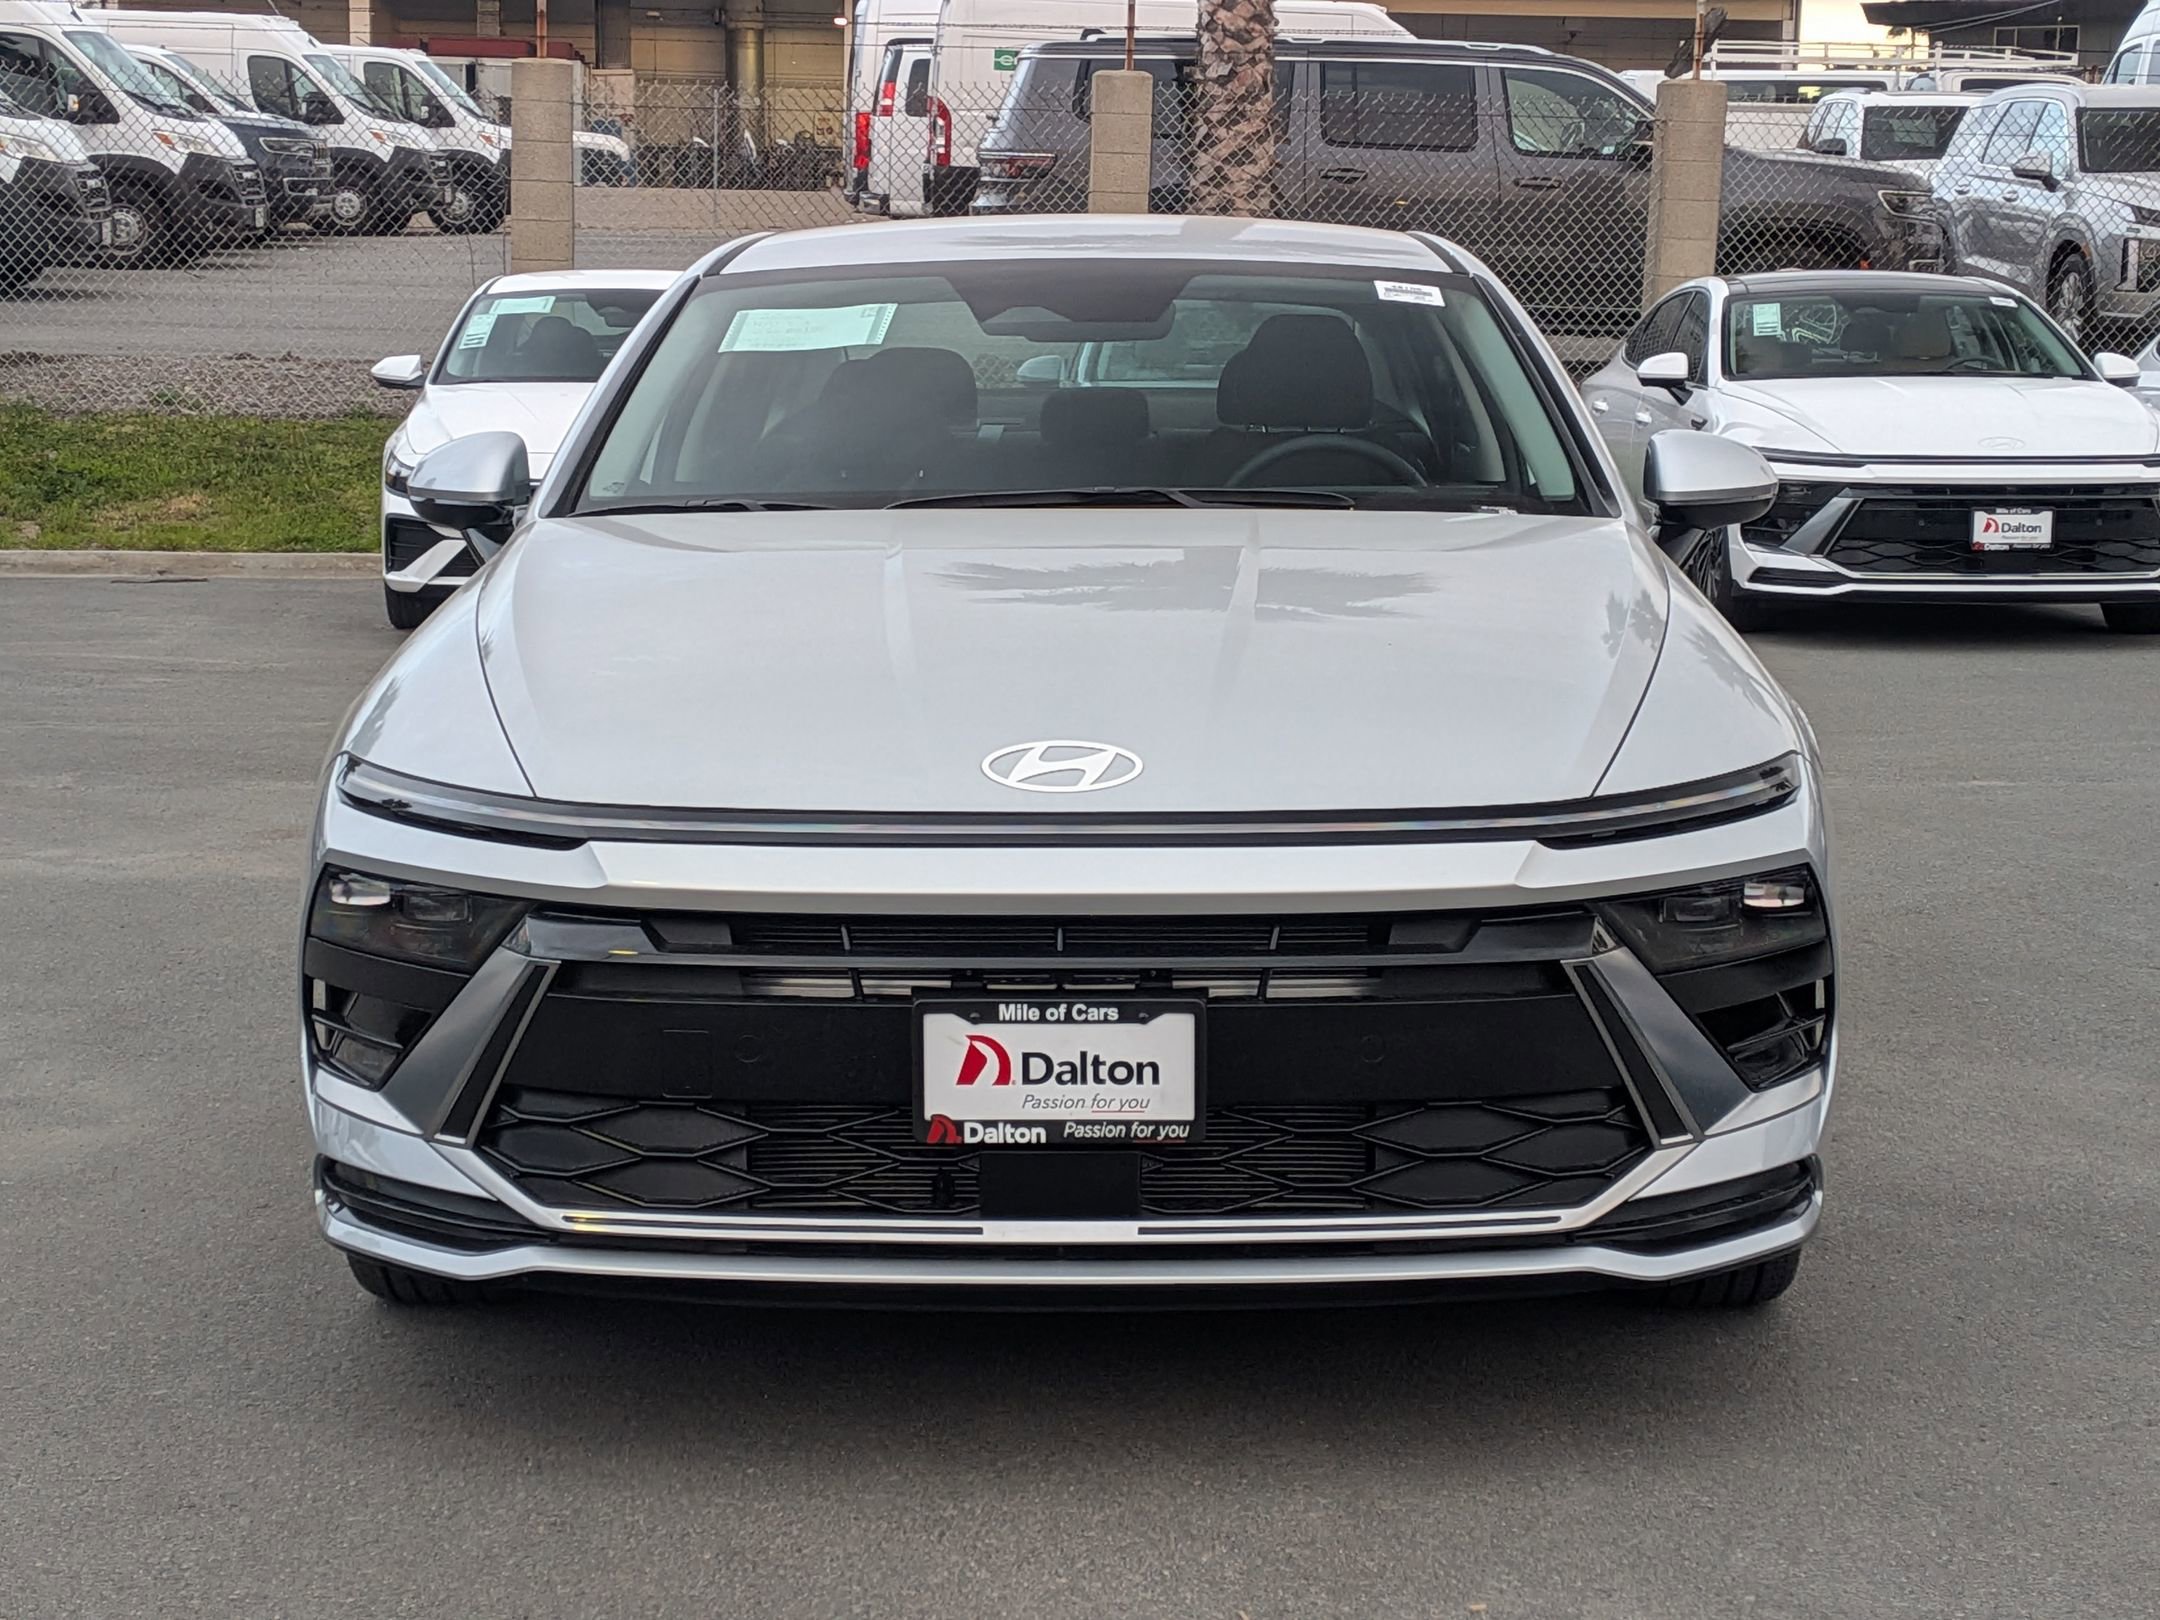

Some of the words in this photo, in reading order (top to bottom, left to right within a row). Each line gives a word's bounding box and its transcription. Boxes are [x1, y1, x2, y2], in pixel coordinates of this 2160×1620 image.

[2001, 522, 2042, 533] Dalton
[999, 1003, 1040, 1021] Mile
[1046, 1003, 1067, 1021] of
[1072, 1003, 1119, 1021] Cars
[1021, 1050, 1160, 1086] Dalton
[1022, 1094, 1086, 1110] Passion
[1091, 1093, 1115, 1110] for
[1117, 1097, 1151, 1111] you
[963, 1121, 1047, 1144] Dalton
[1063, 1121, 1127, 1139] Passion
[1131, 1121, 1155, 1139] for
[1157, 1124, 1190, 1140] you
